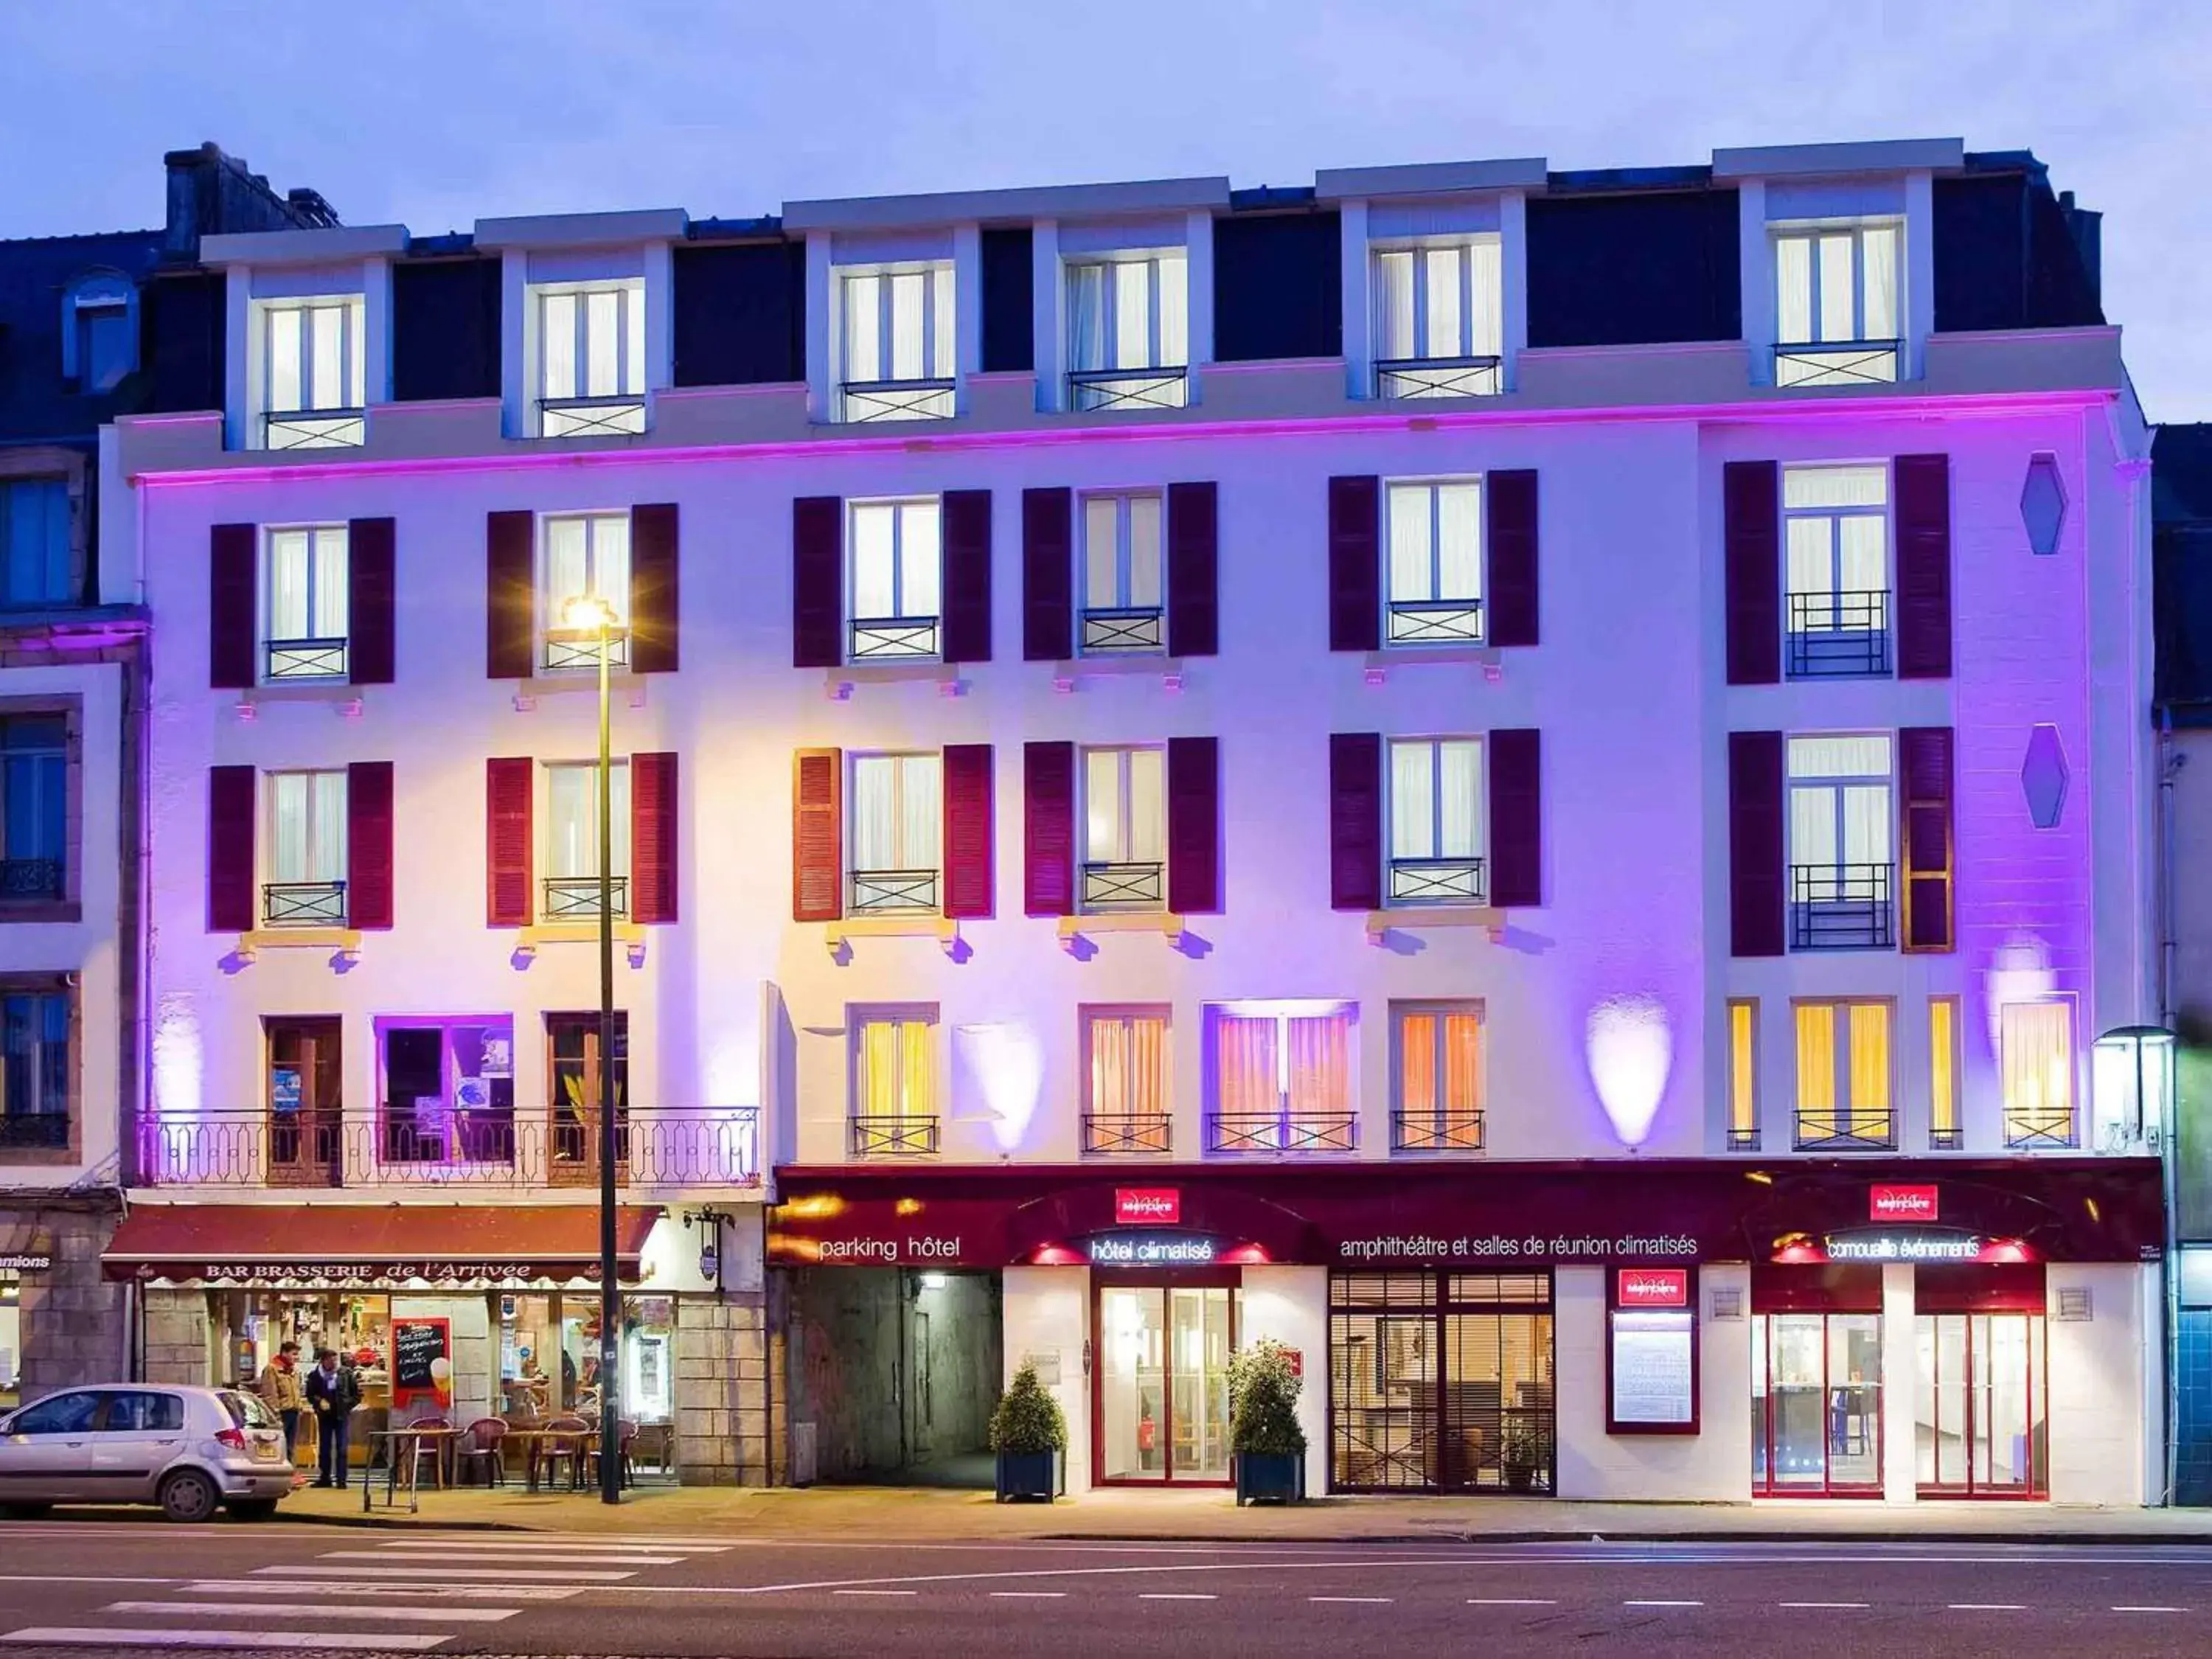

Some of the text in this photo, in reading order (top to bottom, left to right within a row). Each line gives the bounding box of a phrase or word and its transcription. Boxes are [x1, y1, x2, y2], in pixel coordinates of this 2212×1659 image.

[819, 1237, 960, 1262] parking hôtel
[1091, 1240, 1212, 1259] hôtel climatisé
[1340, 1234, 1698, 1261] amphithéâtre et salles de réunion climatisés
[206, 1262, 532, 1278] BAR BRASSERIE de l'Arrivée
